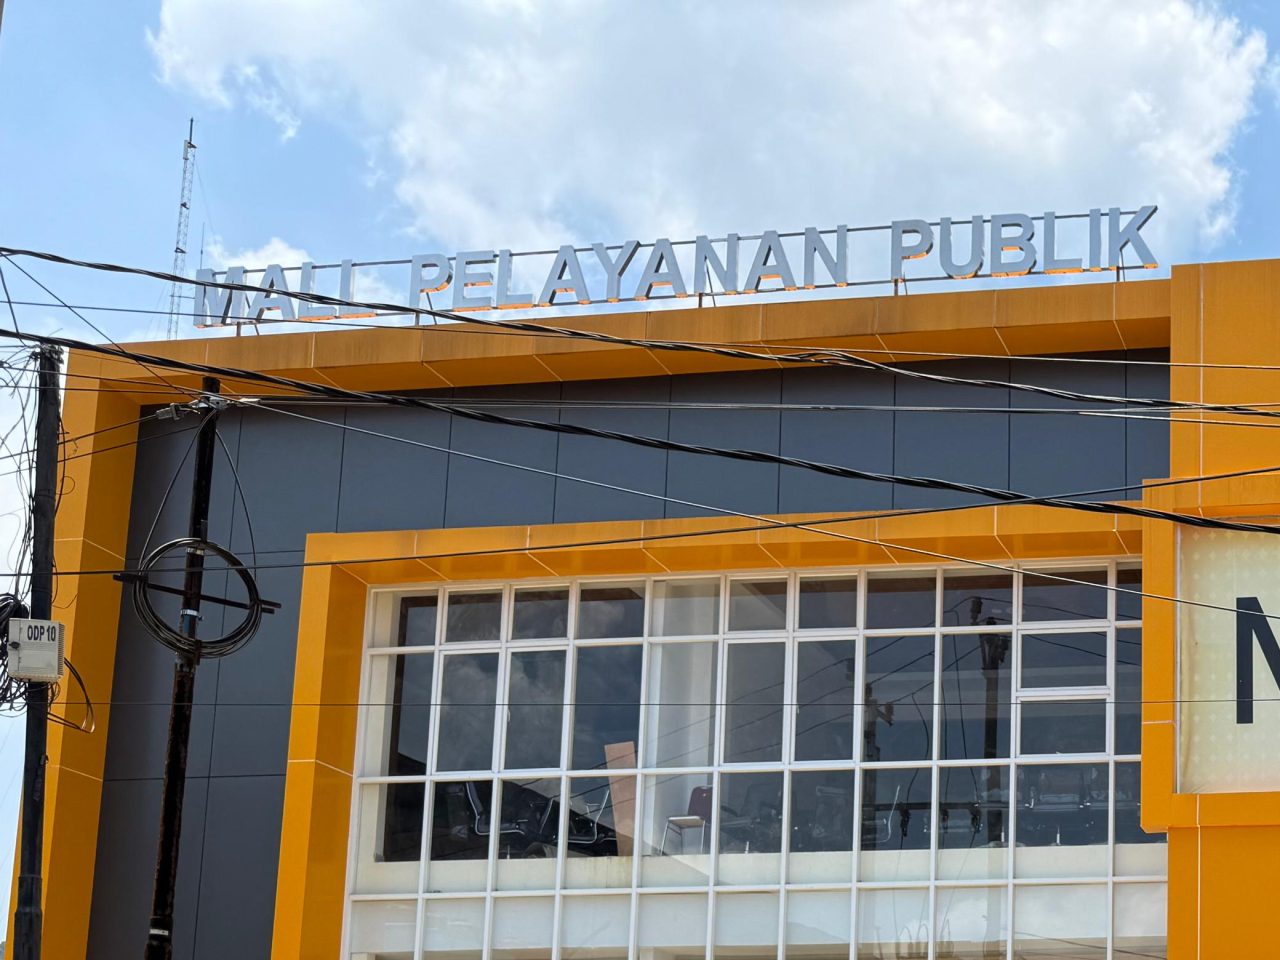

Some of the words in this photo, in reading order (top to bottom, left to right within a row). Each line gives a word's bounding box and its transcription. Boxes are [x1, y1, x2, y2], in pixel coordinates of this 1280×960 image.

[193, 259, 377, 328] MALL
[409, 224, 849, 312] PELAYANAN
[891, 205, 1158, 280] PUBLIK
[27, 625, 45, 641] ODP
[46, 625, 56, 641] 10
